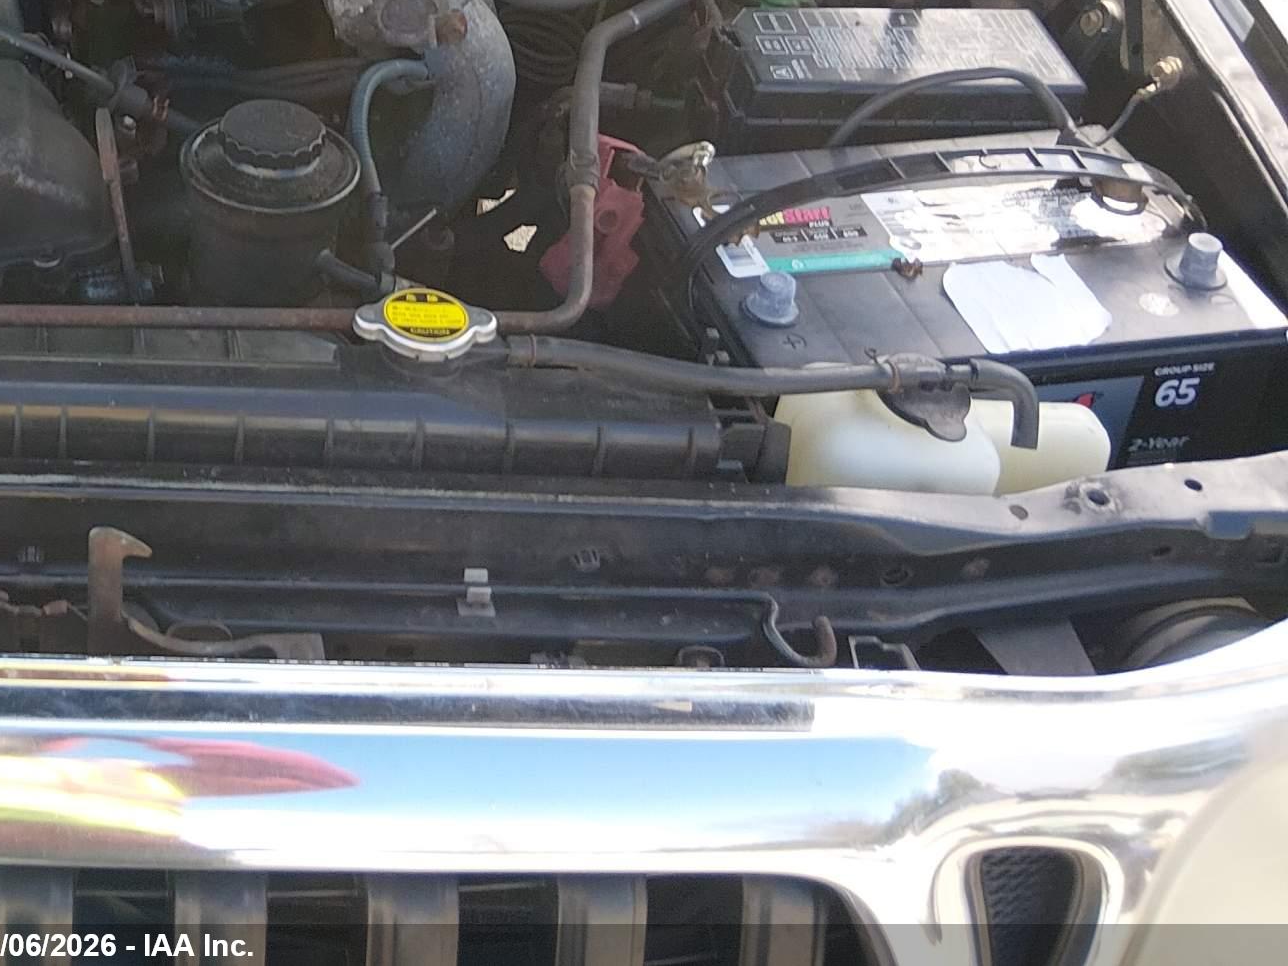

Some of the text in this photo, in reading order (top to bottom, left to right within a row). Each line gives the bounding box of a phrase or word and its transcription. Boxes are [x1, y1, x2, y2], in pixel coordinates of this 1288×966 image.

[1154, 362, 1215, 376] GROUP SIZE
[1155, 377, 1200, 407] 65
